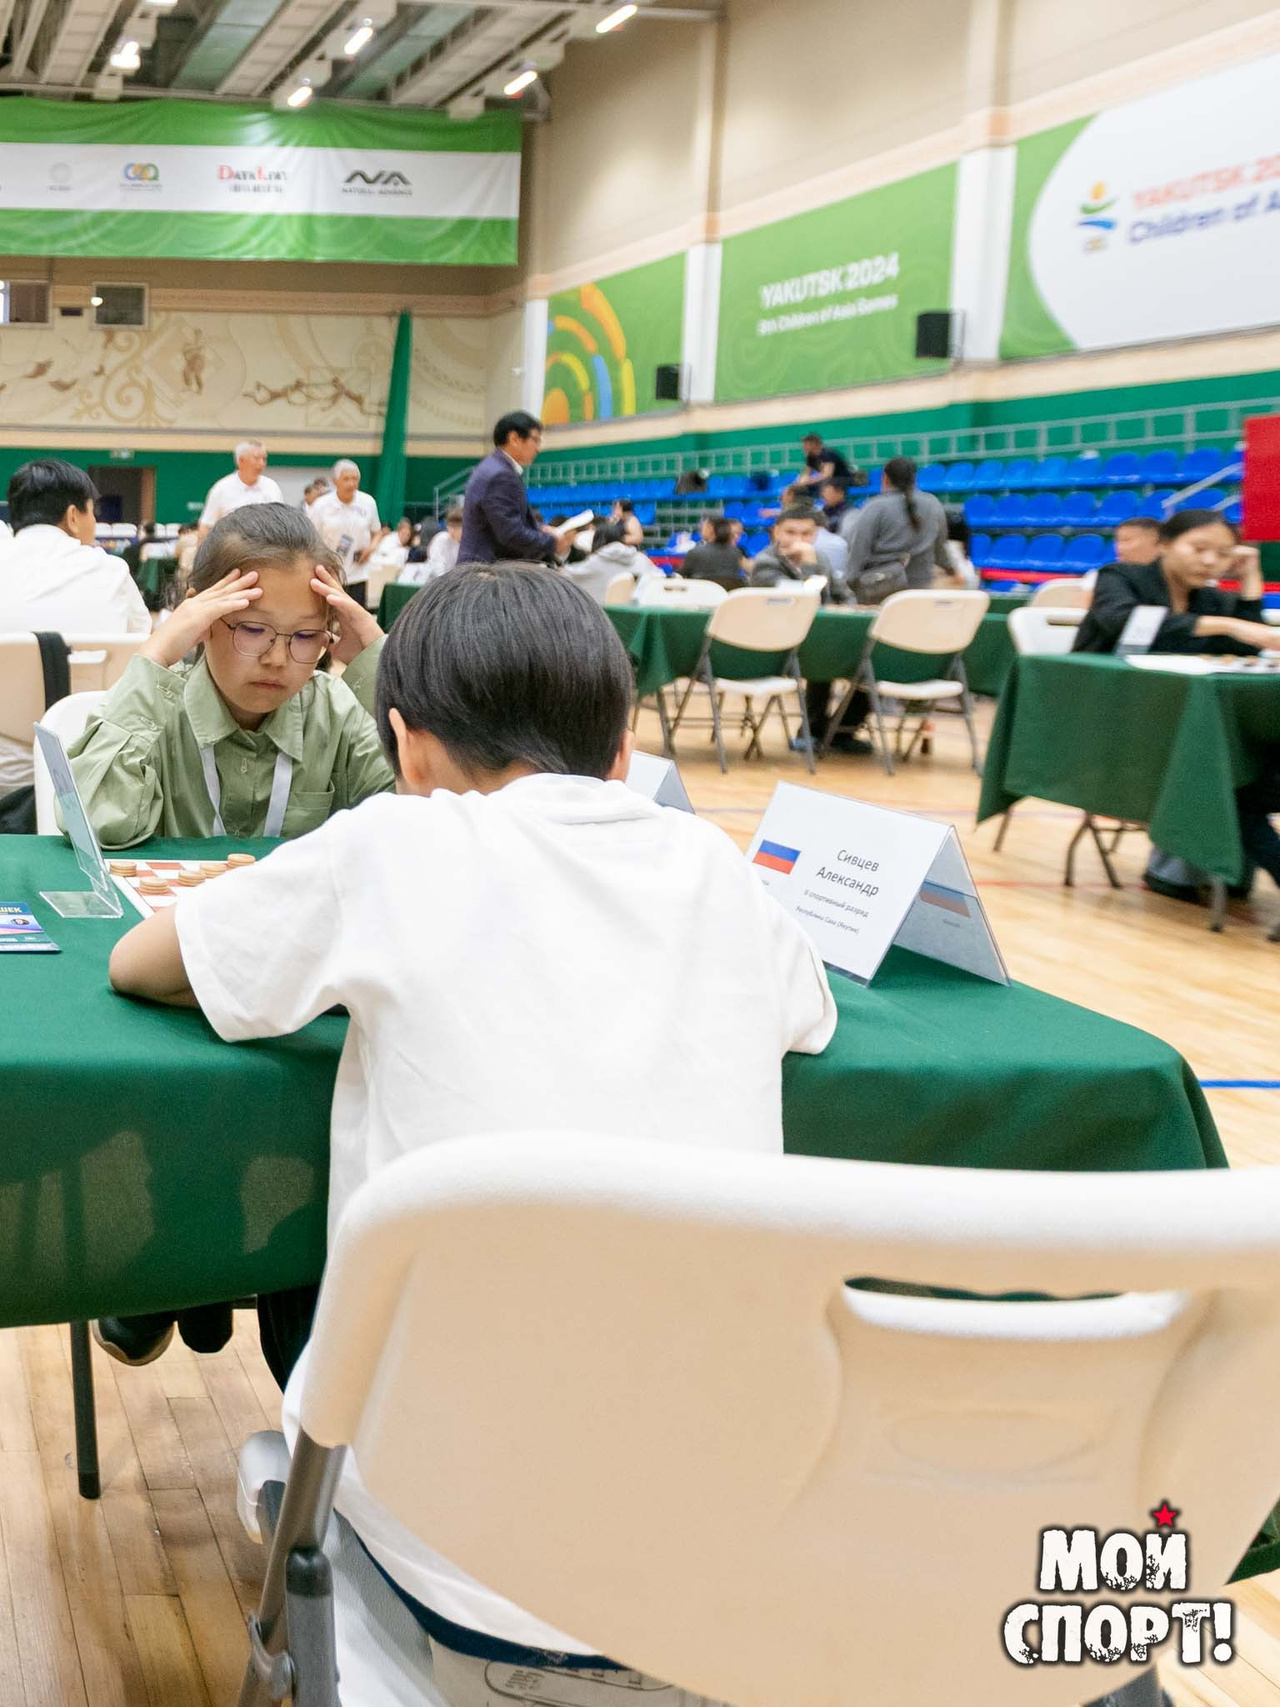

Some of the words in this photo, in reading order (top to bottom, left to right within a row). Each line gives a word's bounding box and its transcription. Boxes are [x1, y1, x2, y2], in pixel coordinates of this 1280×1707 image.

[1133, 165, 1243, 212] YAKUTSK
[1128, 207, 1226, 245] Children
[1233, 192, 1260, 221] of
[761, 267, 843, 309] YAKUTSK
[845, 252, 899, 291] 2024
[778, 312, 819, 332] Children
[832, 303, 856, 321] Asia
[836, 849, 880, 873] Сивцев
[816, 866, 879, 898] Александр
[809, 891, 845, 909] спортивный
[844, 904, 869, 918] разряд
